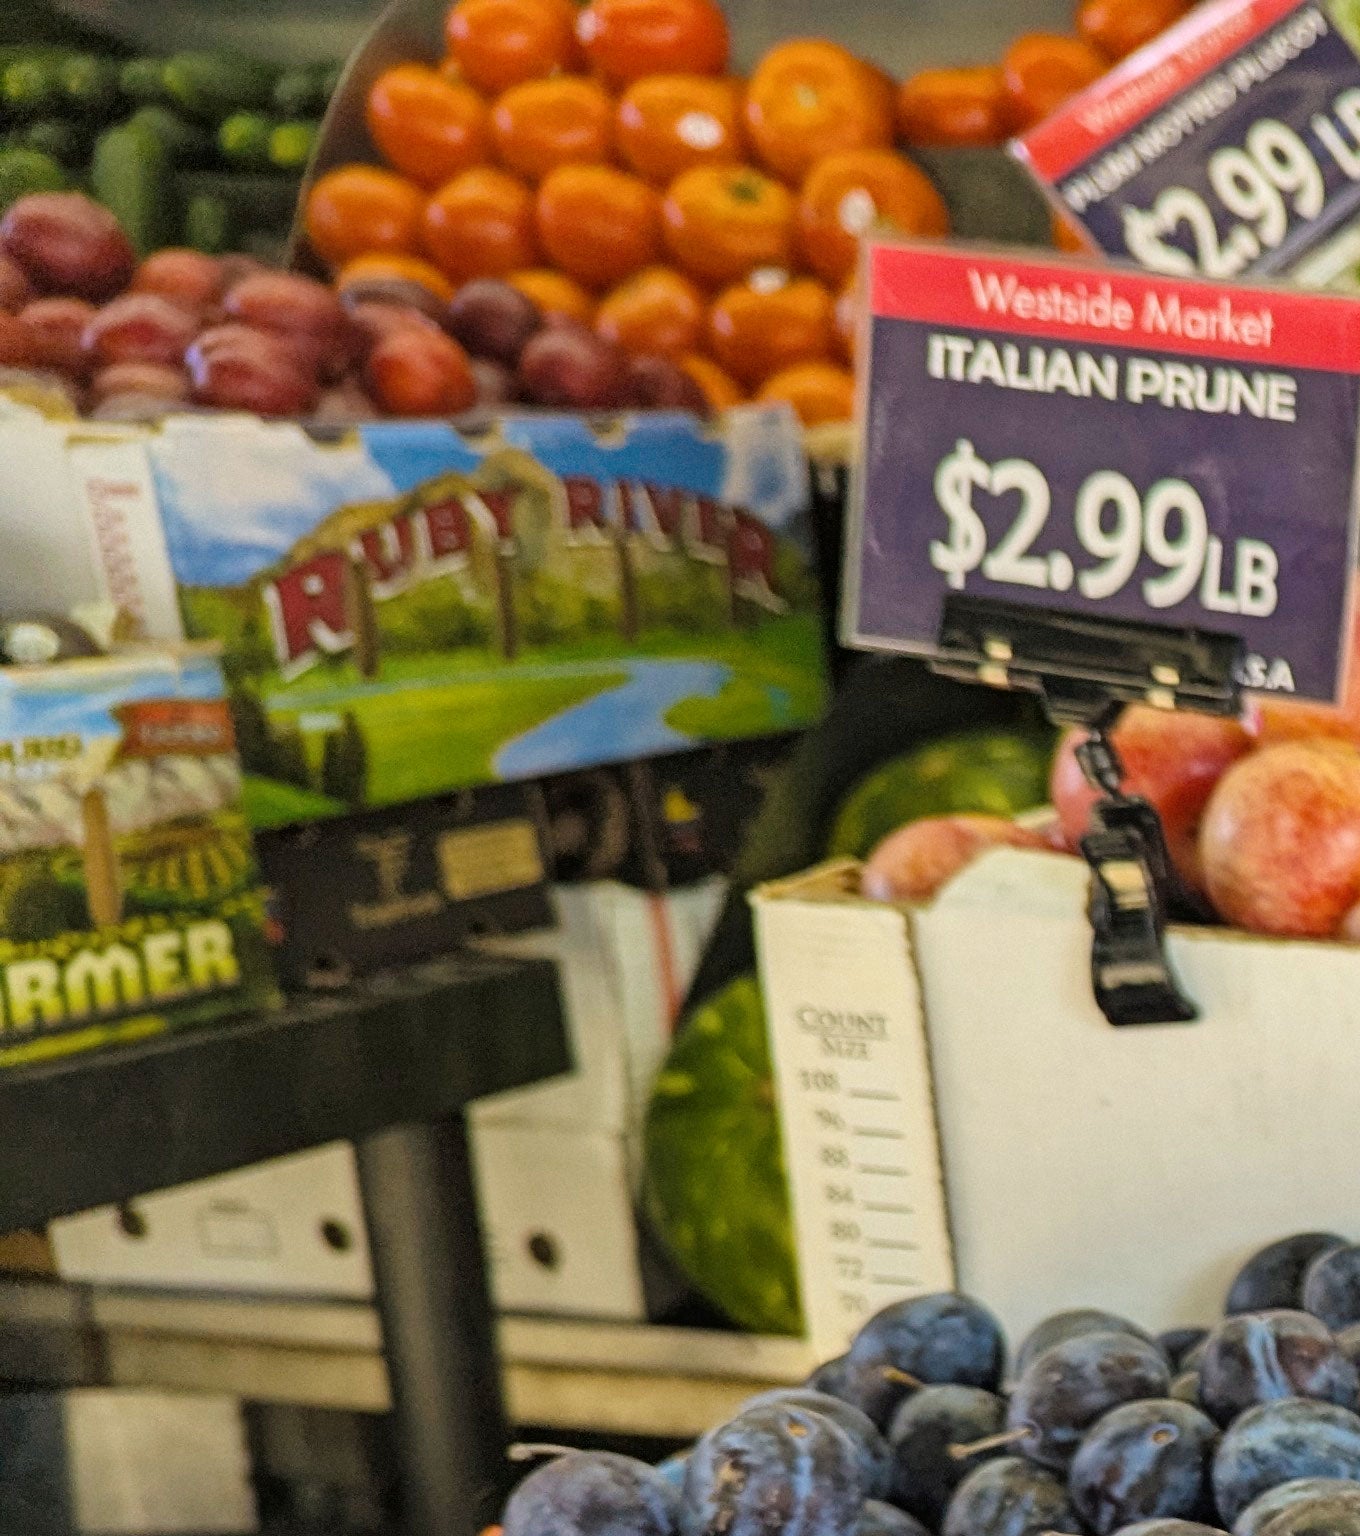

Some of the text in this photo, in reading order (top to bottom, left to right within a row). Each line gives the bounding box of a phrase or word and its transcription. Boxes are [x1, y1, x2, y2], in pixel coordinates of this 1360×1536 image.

[967, 268, 1272, 348] Westside Market
[927, 333, 1297, 423] ITALIAN PRUNE
[0, 919, 240, 1034] RMER
